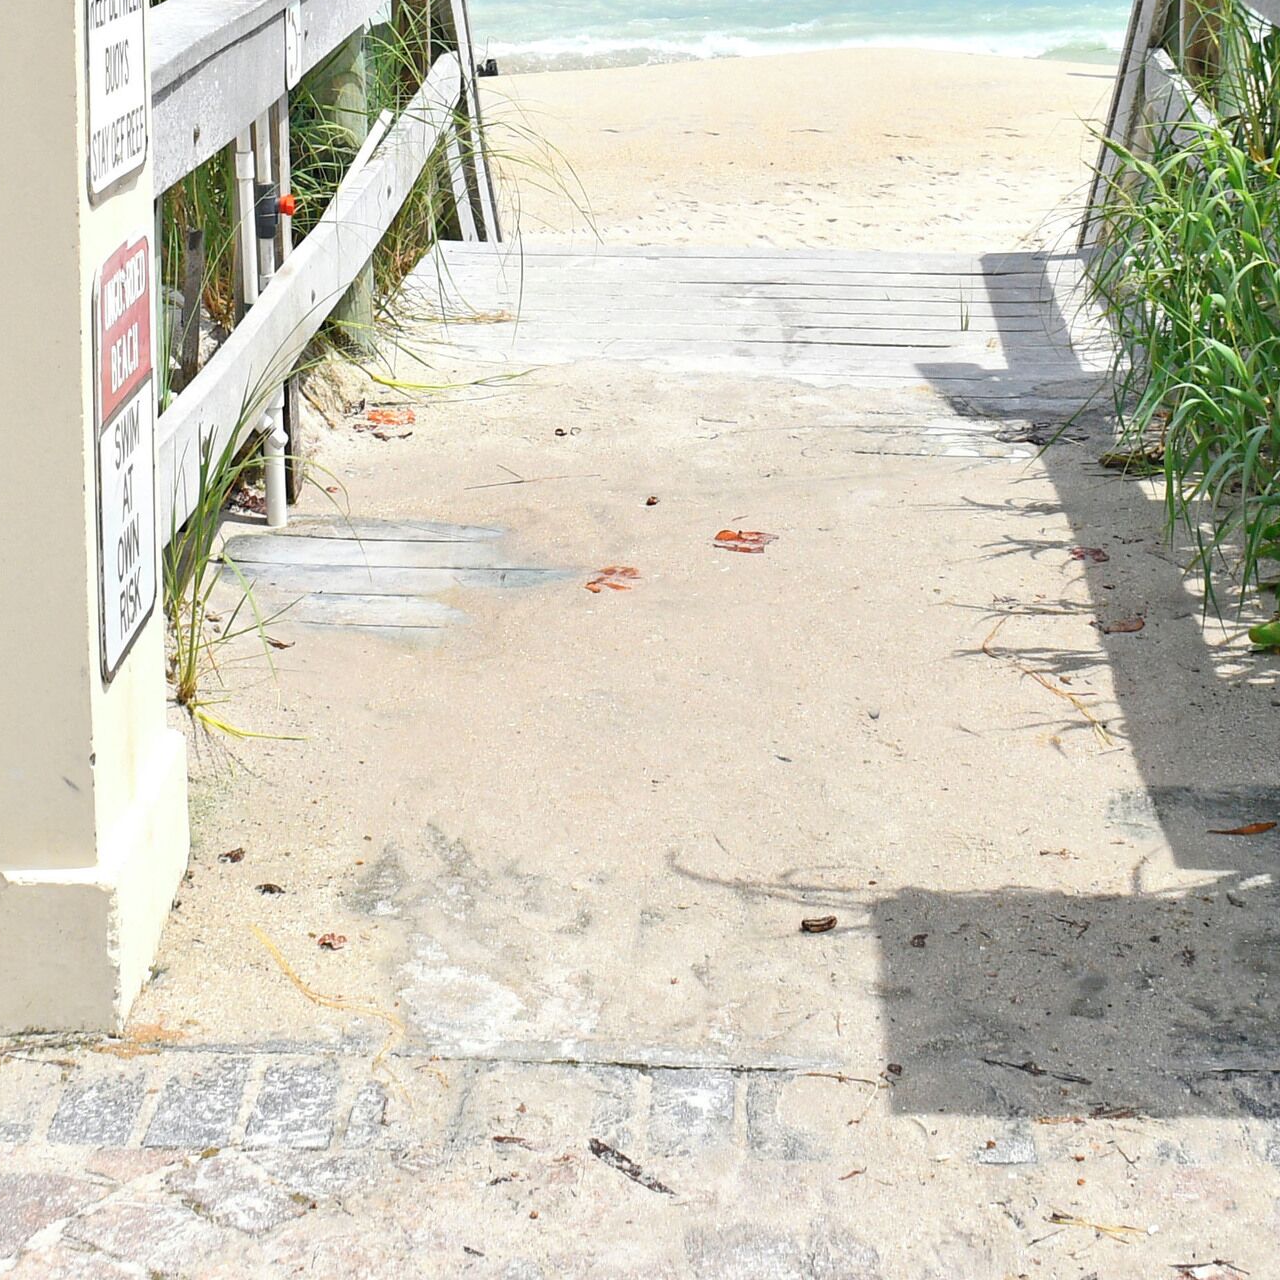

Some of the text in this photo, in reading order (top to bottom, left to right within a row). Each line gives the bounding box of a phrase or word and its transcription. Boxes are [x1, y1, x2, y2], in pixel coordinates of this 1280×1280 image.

[105, 39, 130, 95] BUOYS
[92, 104, 144, 182] STAY OFF REEF
[111, 322, 139, 394] BEACH
[114, 399, 140, 471] SWIM
[122, 463, 134, 523] AT
[117, 512, 140, 583] OWN
[120, 566, 142, 640] RISK
